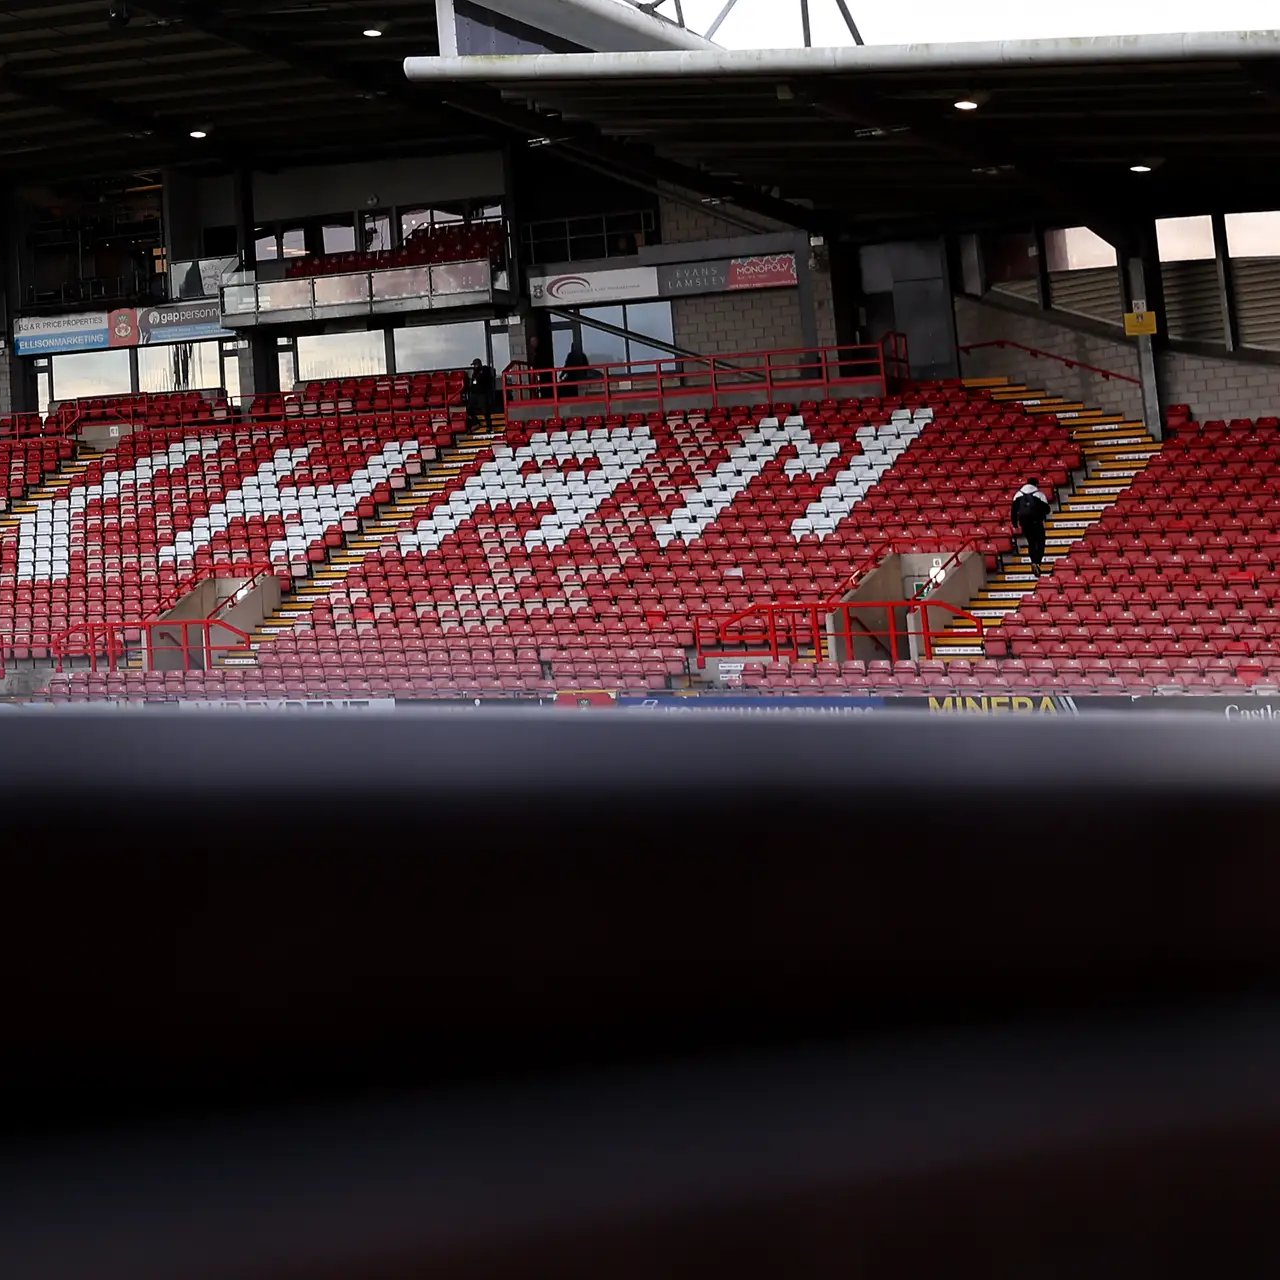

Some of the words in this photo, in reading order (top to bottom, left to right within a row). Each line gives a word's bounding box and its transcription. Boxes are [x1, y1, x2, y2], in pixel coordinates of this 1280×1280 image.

[675, 267, 718, 279] EVANS
[736, 262, 789, 276] MONOPOLY
[667, 275, 727, 289] LAMSLEY
[63, 316, 104, 327] PROPERTIES
